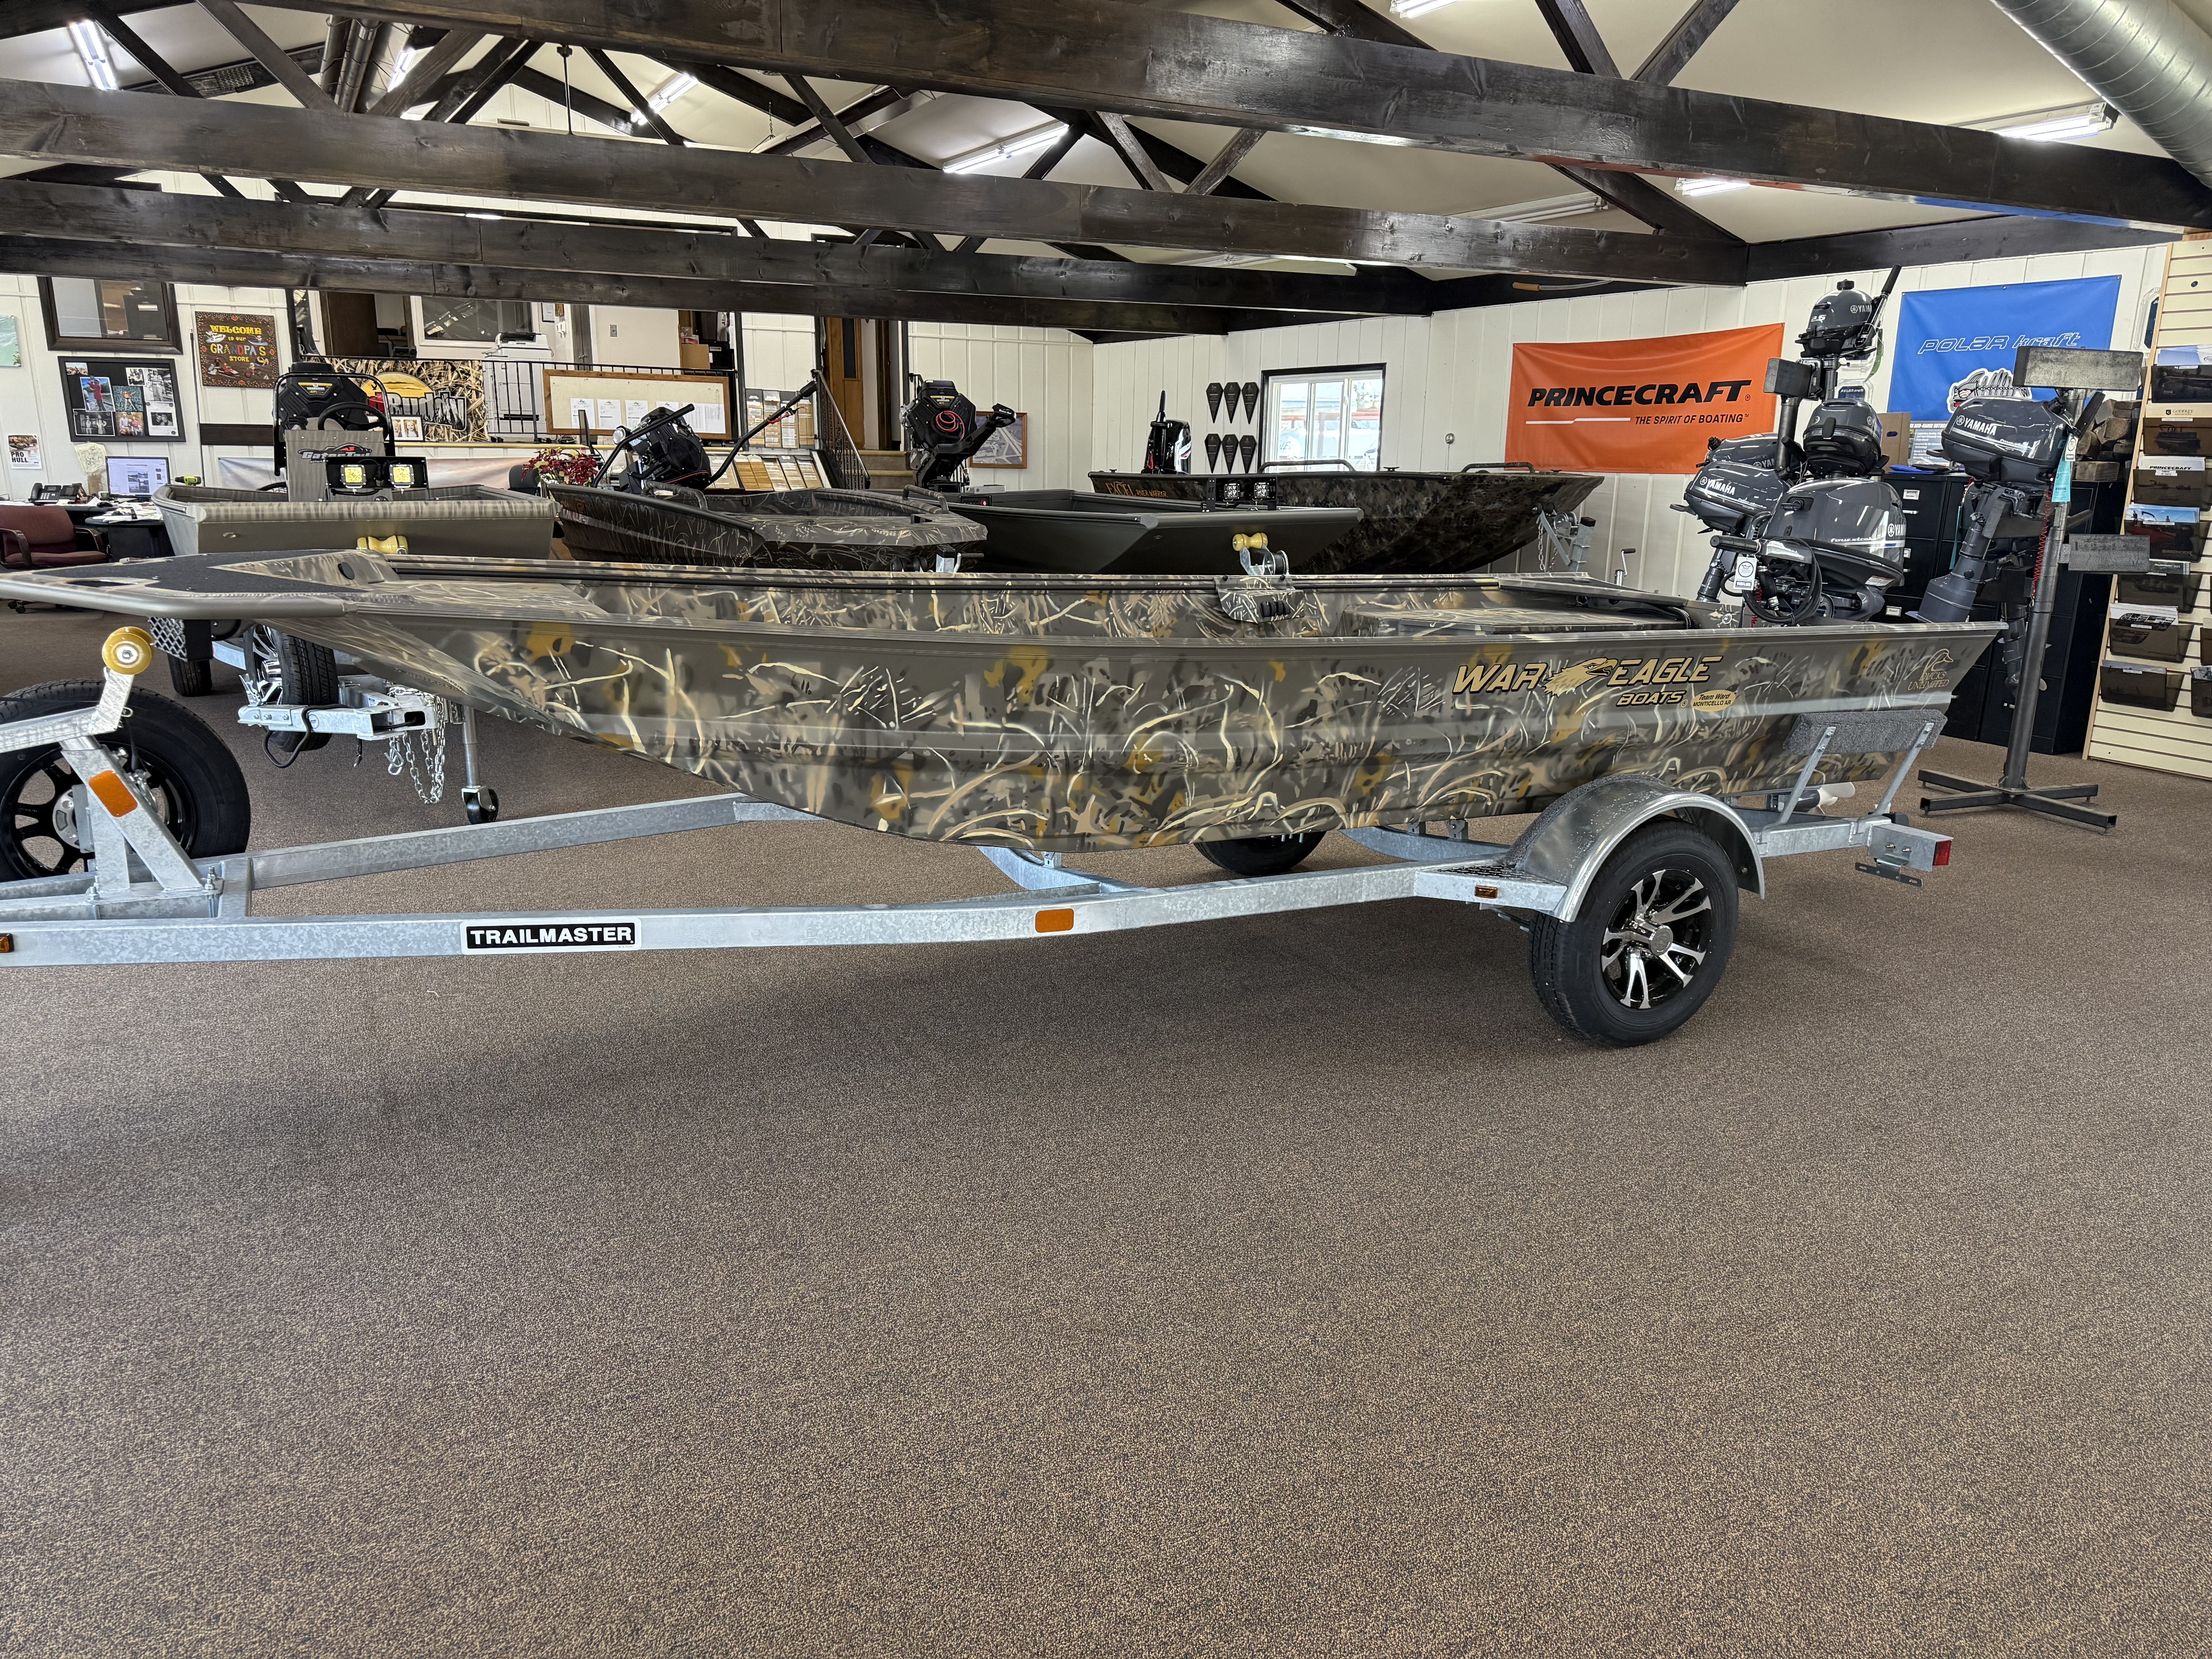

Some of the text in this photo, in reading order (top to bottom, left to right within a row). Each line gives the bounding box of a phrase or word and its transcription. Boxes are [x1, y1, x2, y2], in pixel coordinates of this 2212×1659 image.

[210, 325, 262, 335] WELCOME
[210, 343, 266, 356] GRANDPA'S
[1528, 380, 1752, 407] PRINCECRAFT
[1635, 414, 1743, 424] THE SPIRIT OF BOATING
[1964, 417, 1997, 436] YAMAHA
[1106, 481, 1137, 496] EXCEL
[1707, 479, 1736, 495] YAMAHA
[1452, 656, 1723, 694] WAR EAGLE
[1919, 672, 1947, 681] DUCKS
[1908, 680, 1949, 690] UNLIMITED
[1616, 690, 1687, 707] BOATS
[470, 927, 632, 945] TRAILMASTER
